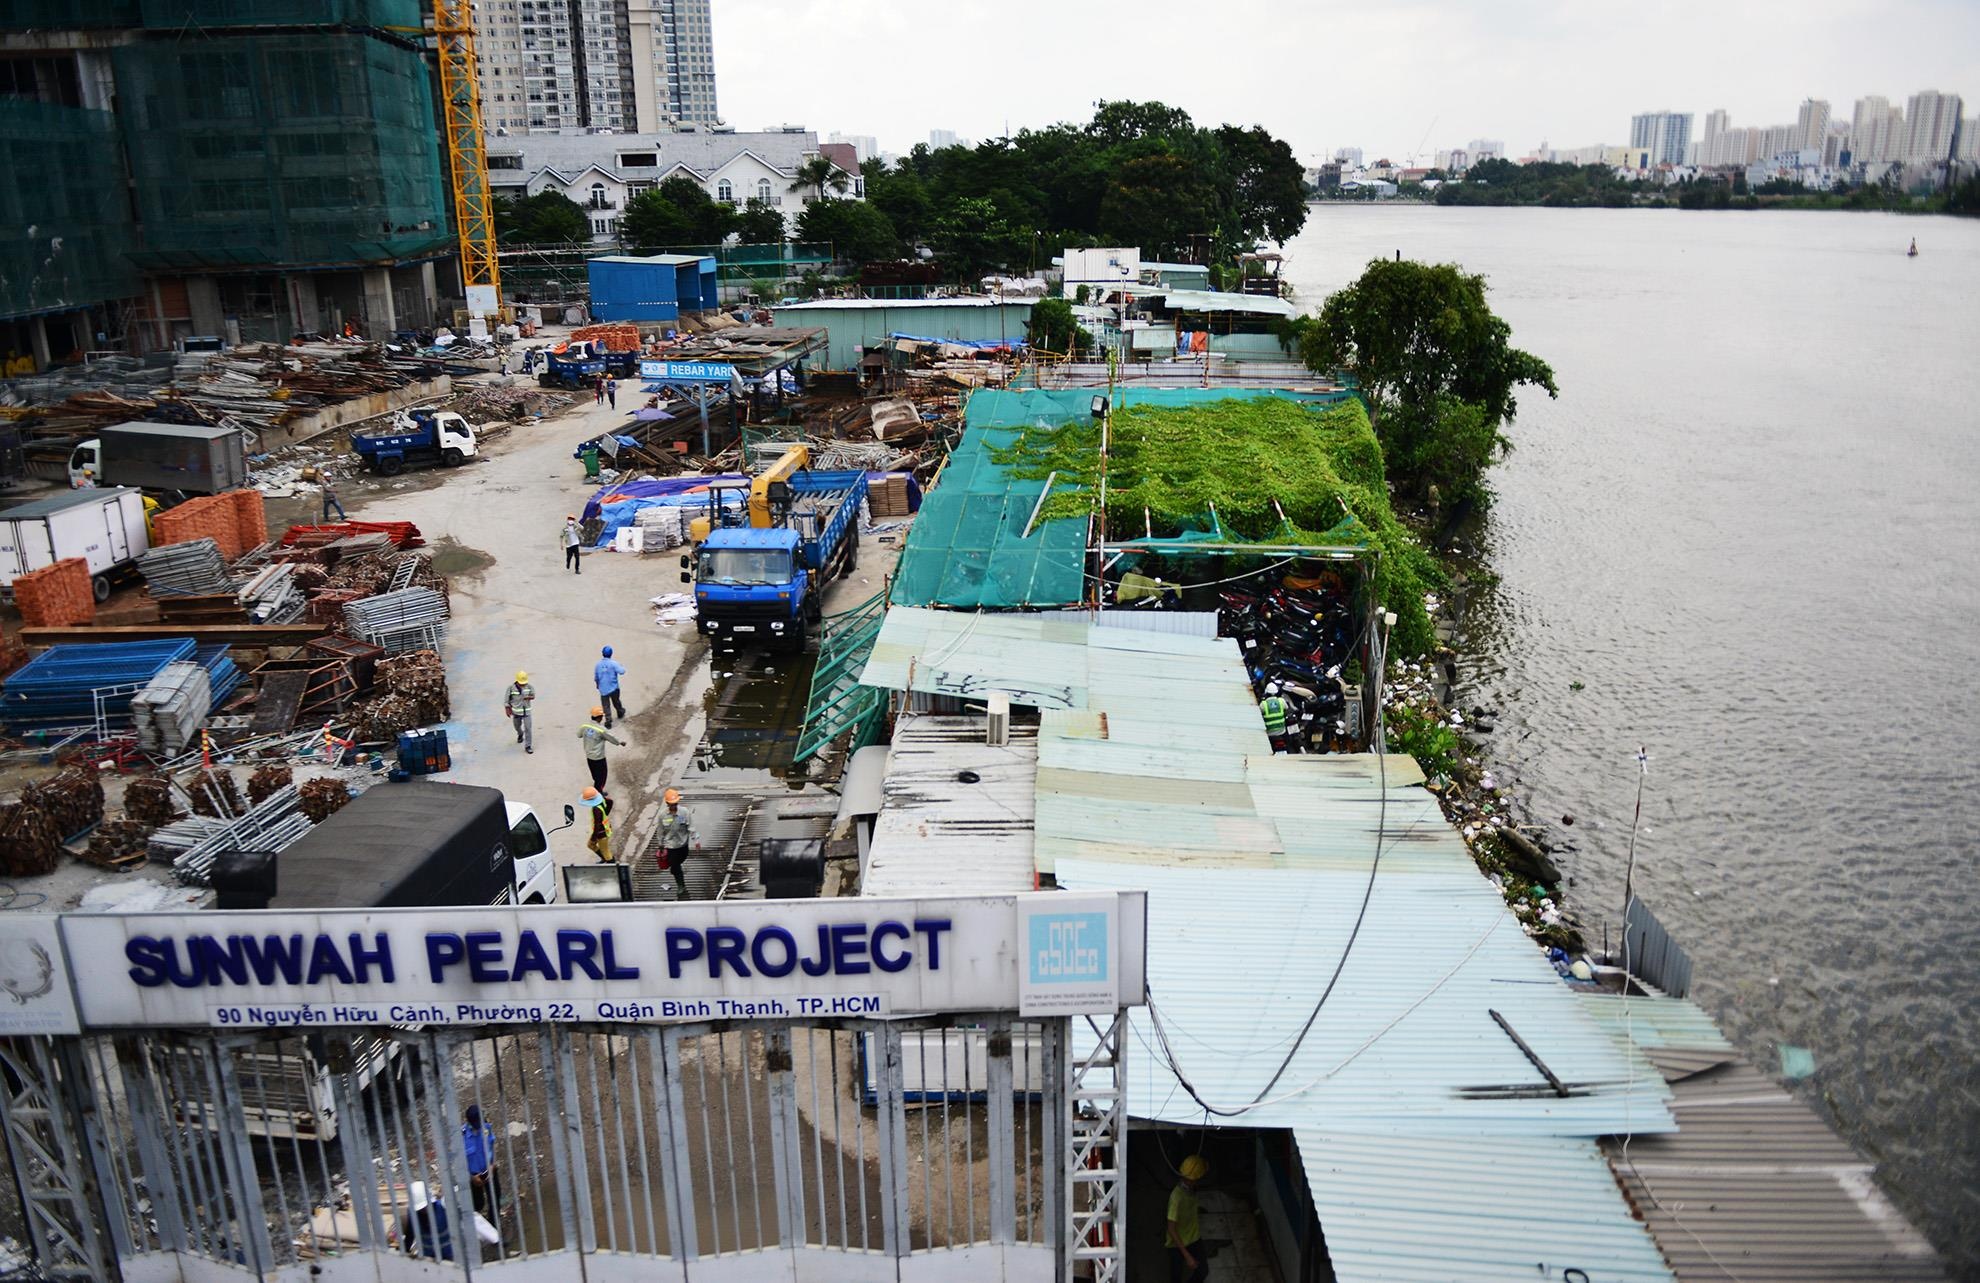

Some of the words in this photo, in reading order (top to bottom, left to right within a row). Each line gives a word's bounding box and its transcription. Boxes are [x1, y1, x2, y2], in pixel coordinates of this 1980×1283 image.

[670, 364, 705, 376] REBAR
[124, 932, 395, 987] SUNWAH
[424, 929, 641, 983] PEARL
[665, 919, 952, 979] PROJECT
[219, 1008, 242, 1024] 90
[247, 1003, 327, 1026] Nguyễn
[333, 1005, 379, 1023] Hữu
[389, 1003, 450, 1023] Cảnh,
[457, 1003, 542, 1023] Phường
[549, 1003, 581, 1021] 22,
[597, 1003, 654, 1020] Quận
[661, 1001, 710, 1017] Bình
[717, 999, 790, 1018] Thạnh,
[799, 996, 880, 1014] TP.HCM
